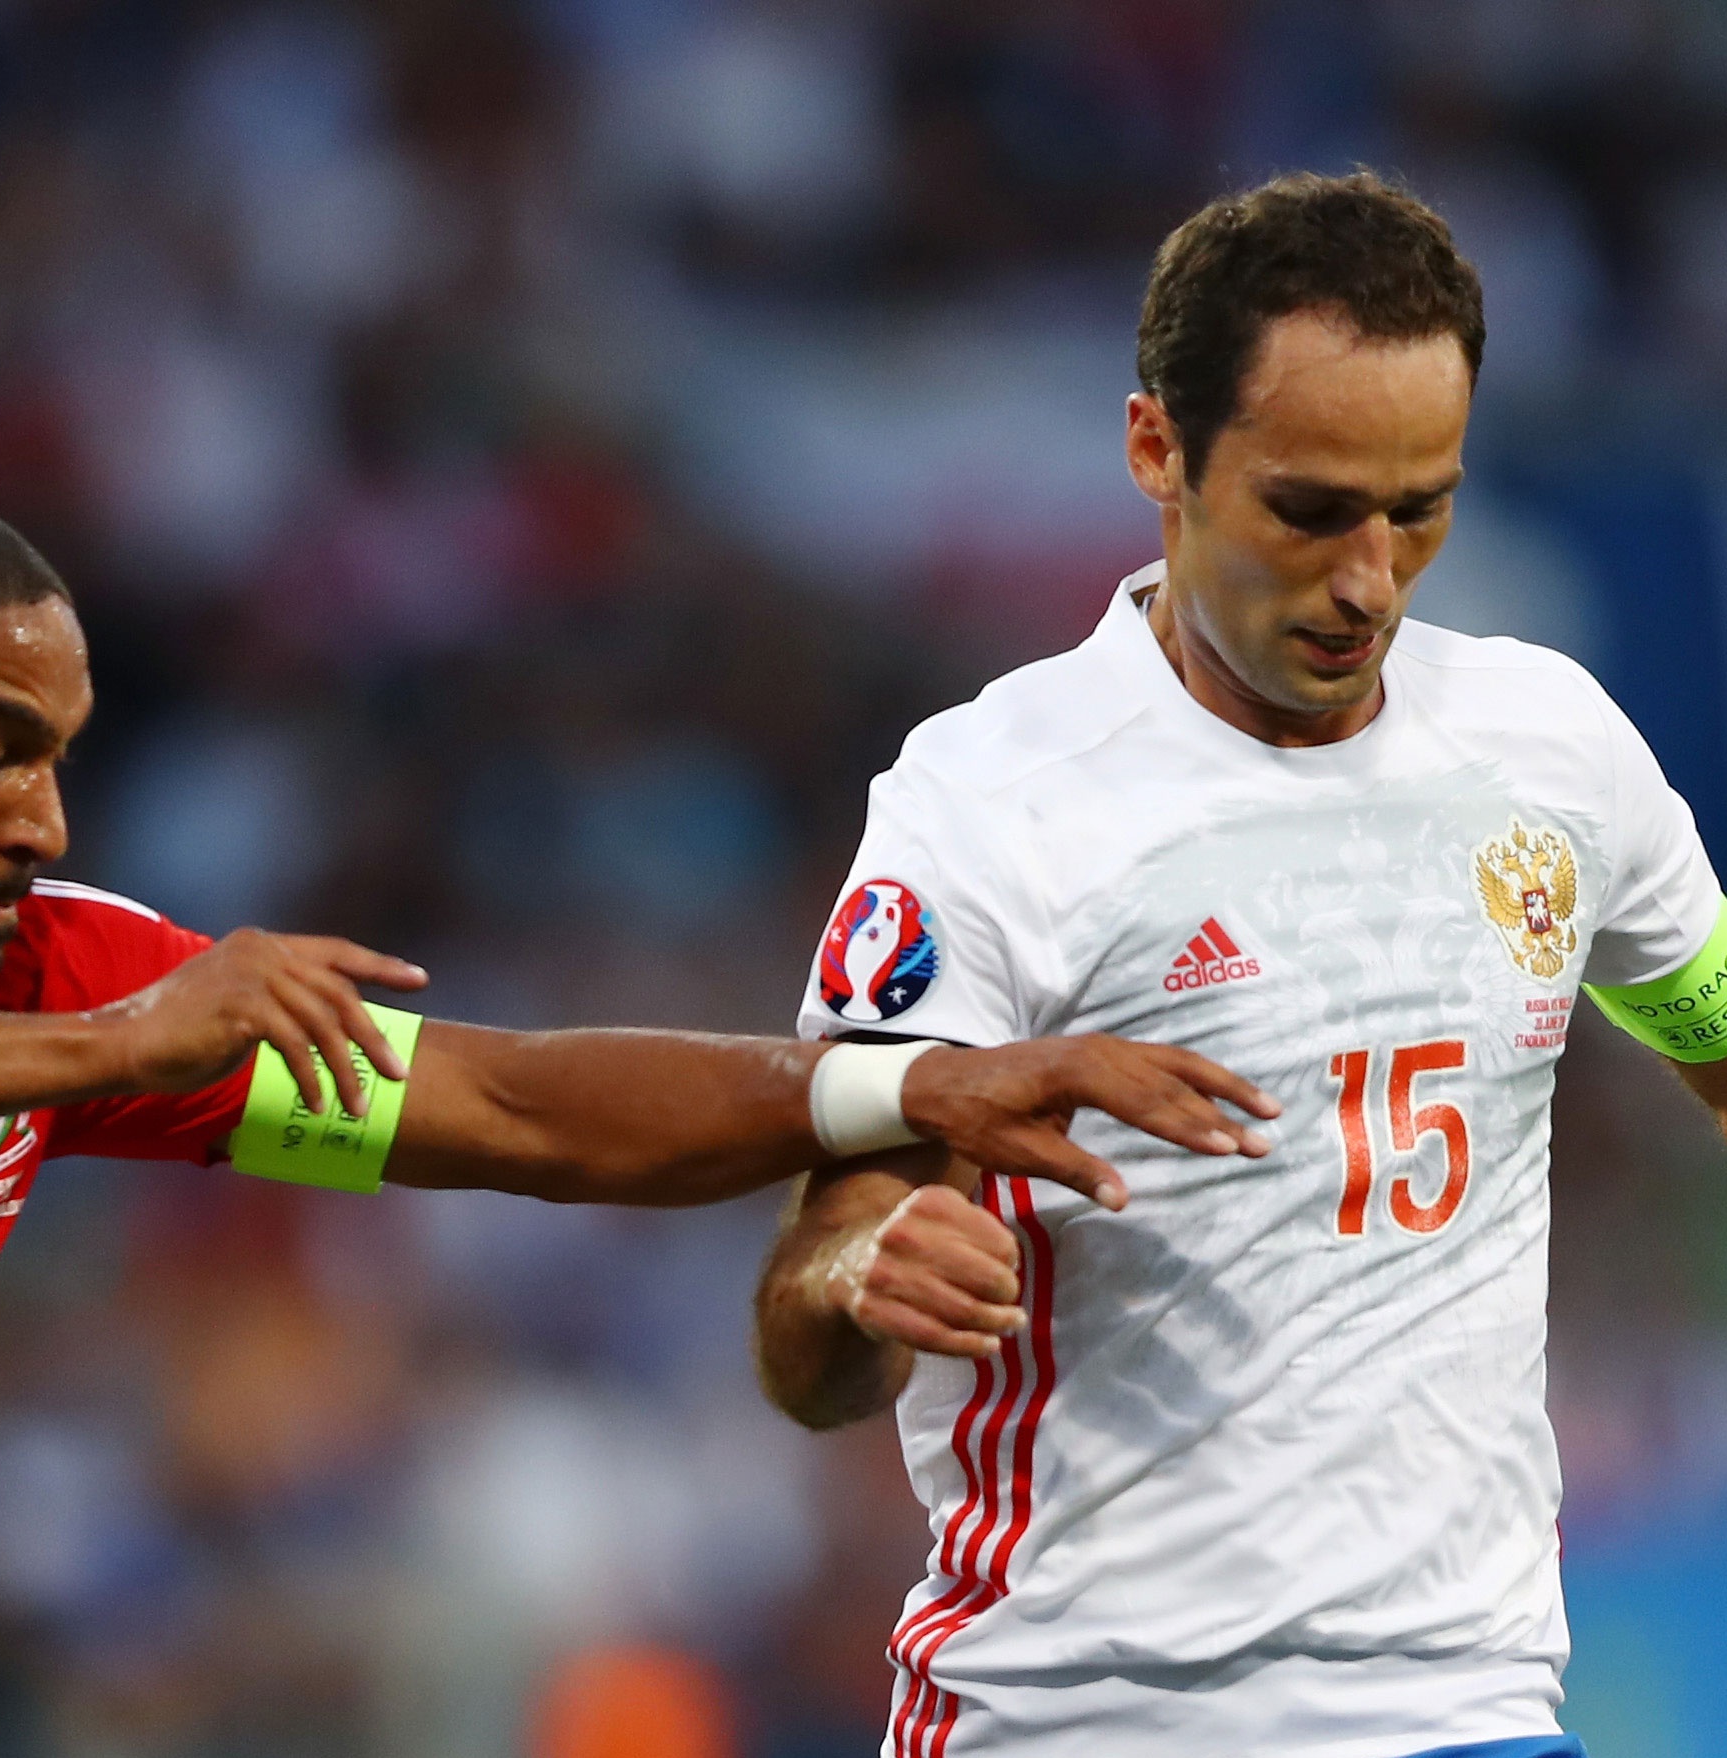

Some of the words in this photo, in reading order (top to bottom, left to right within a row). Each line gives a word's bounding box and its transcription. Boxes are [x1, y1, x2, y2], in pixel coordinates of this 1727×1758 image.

[1163, 957, 1261, 992] adidas
[1659, 997, 1696, 1015] TO
[1329, 1038, 1471, 1238] 15
